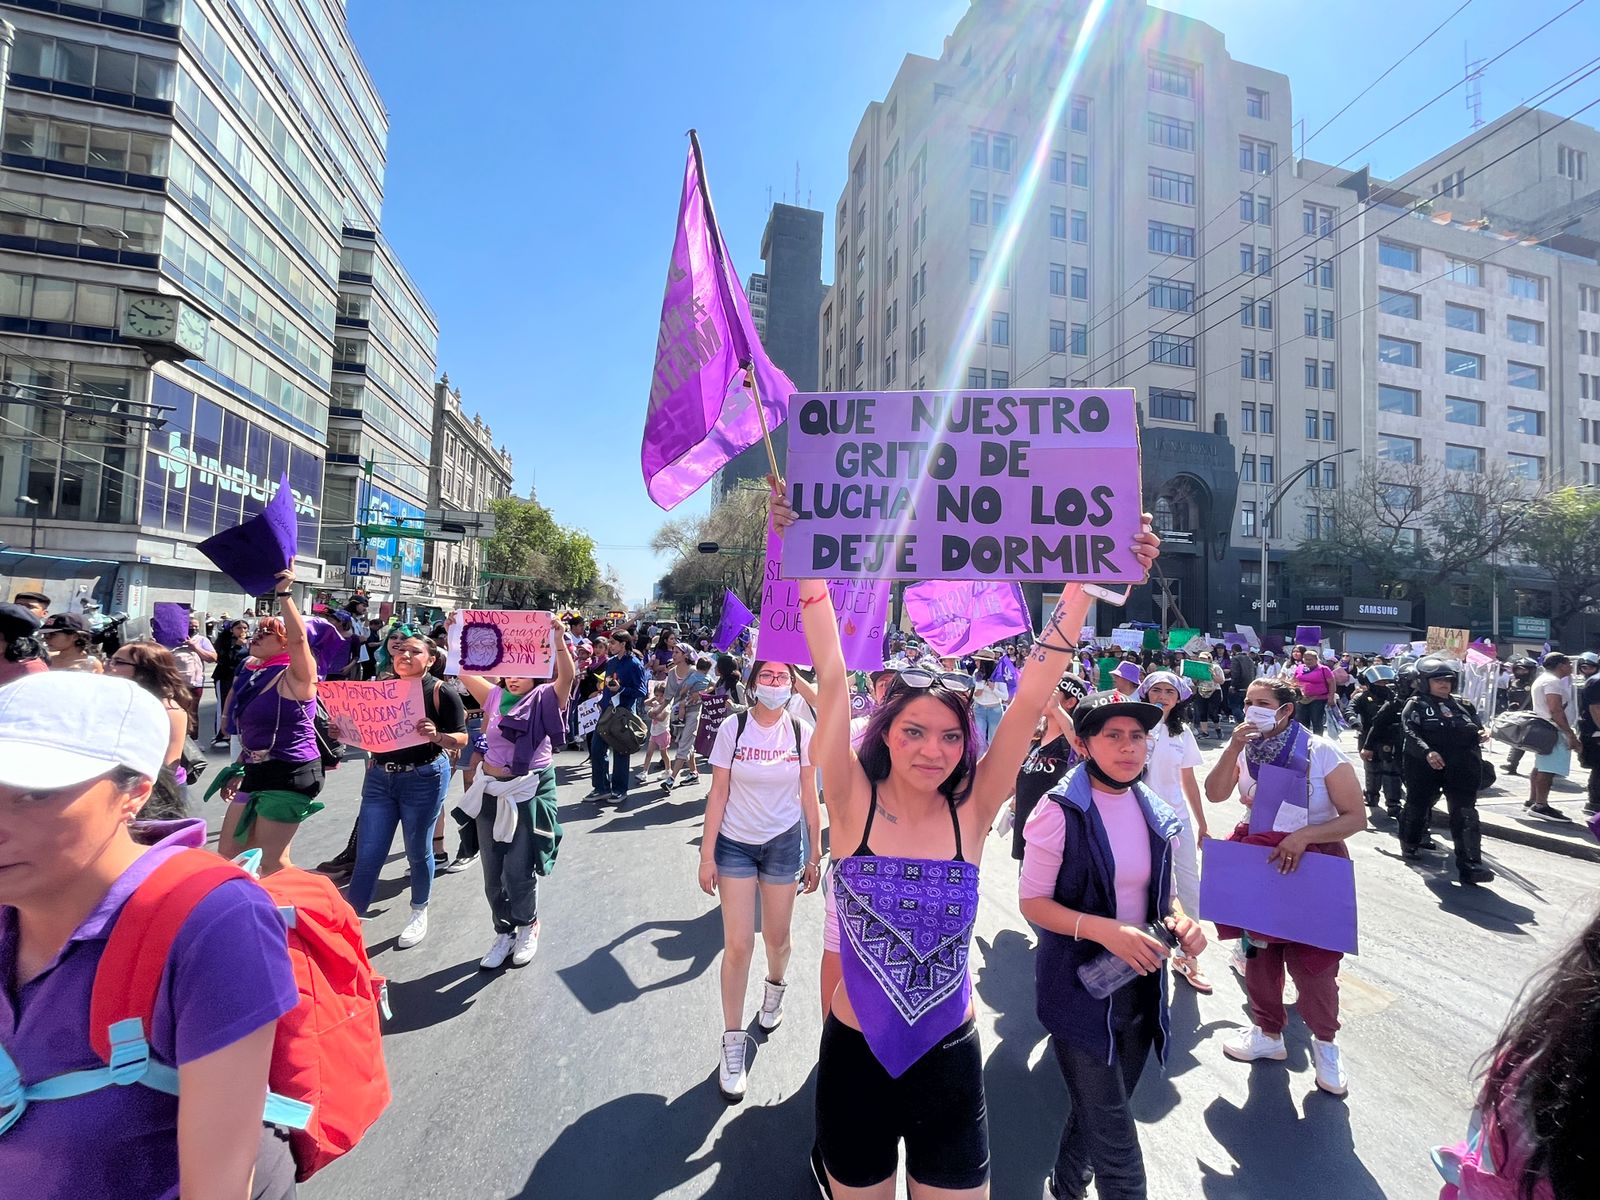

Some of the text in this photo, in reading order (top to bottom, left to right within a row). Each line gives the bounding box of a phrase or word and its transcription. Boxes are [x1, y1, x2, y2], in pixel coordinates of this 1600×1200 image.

[799, 400, 875, 436] QUE
[911, 396, 1110, 436] NUESTRO
[836, 441, 1031, 480] GRITO DE
[792, 483, 1115, 527] LUCHA NO LOS
[812, 534, 1122, 575] DEJE DORMIR
[116, 577, 125, 605] MINISO
[763, 585, 773, 605] A
[786, 587, 801, 607] L
[465, 610, 510, 625] SOMOS
[1306, 604, 1340, 612] SAMSUNG
[1359, 604, 1399, 616] SAMSUNG
[770, 609, 803, 633] QUE
[519, 643, 536, 653] NO
